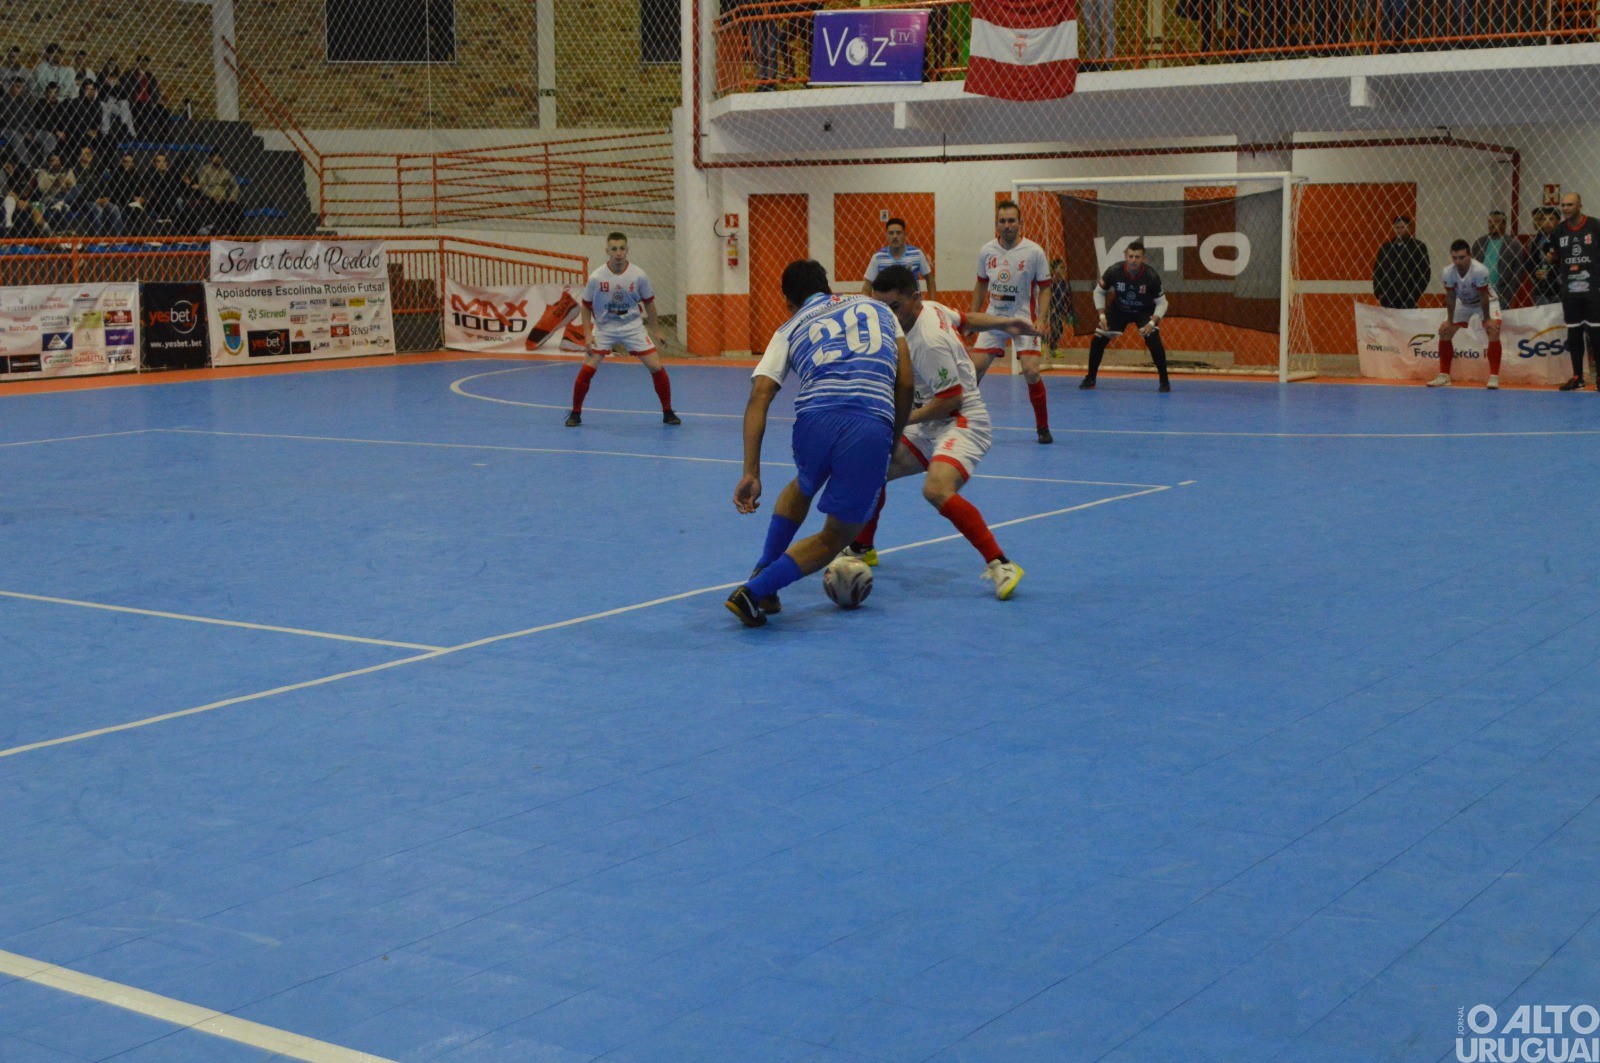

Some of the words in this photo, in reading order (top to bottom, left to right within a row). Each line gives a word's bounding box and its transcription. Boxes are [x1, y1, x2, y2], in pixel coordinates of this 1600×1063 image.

[898, 32, 911, 42] TV
[278, 248, 320, 270] todos
[324, 246, 380, 274] Rodeio
[1094, 232, 1250, 276] KTO
[216, 286, 272, 300] Apoiadores
[276, 284, 322, 296] Escolinha
[324, 282, 356, 294] Rodeio
[358, 282, 385, 292] Futsal
[148, 307, 190, 326] yesbet
[259, 308, 286, 318] Sicredi
[451, 293, 528, 325] MAX
[452, 312, 528, 332] 1000
[252, 336, 280, 352] yesbet
[808, 303, 882, 367] 20
[150, 340, 202, 349] www.yesbet.bet
[1414, 348, 1480, 358] Fecoércio
